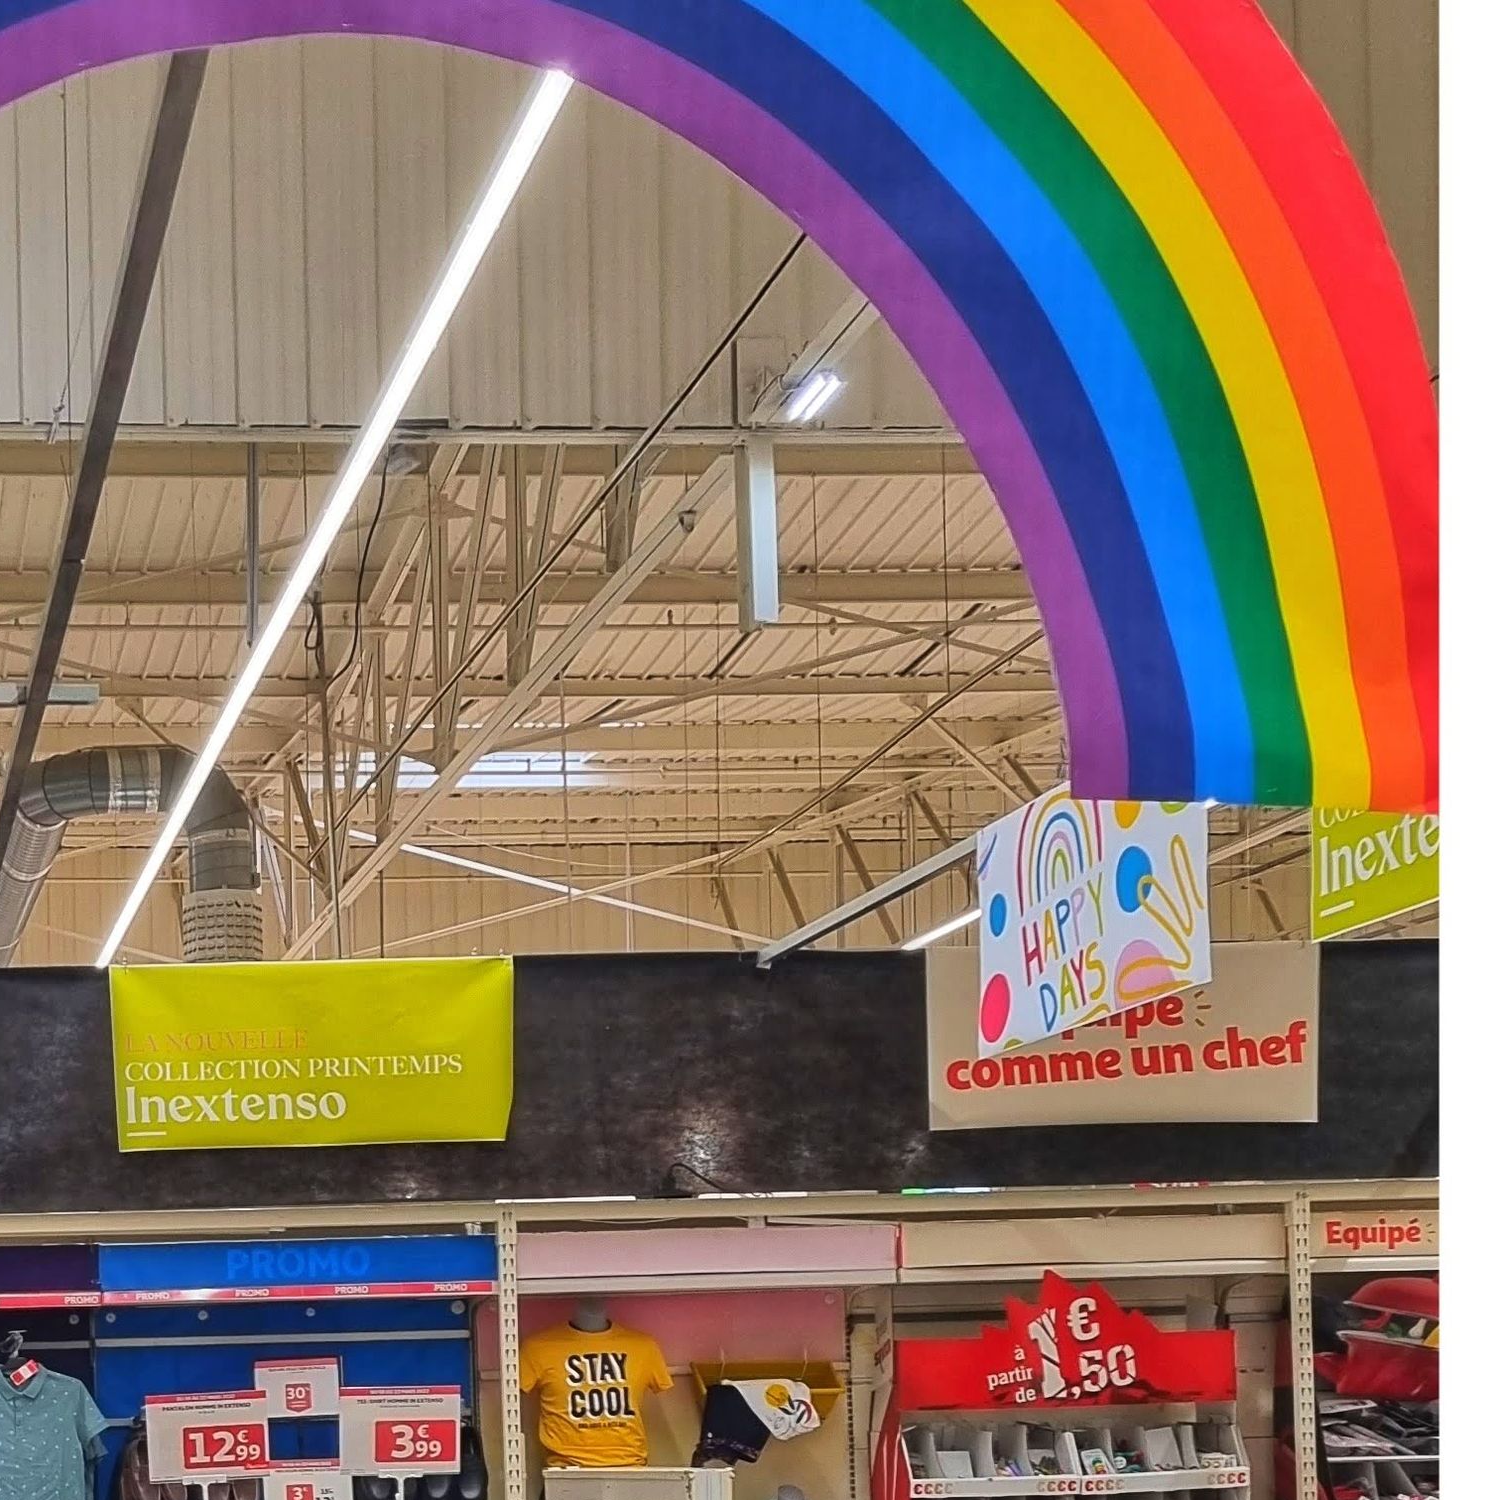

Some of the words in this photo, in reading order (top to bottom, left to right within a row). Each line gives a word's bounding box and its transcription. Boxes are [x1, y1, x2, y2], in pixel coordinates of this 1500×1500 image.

[1022, 873, 1105, 986] HAPPY
[1039, 942, 1108, 1033] DAYS
[125, 1032, 158, 1053] LA
[167, 1030, 308, 1053] NOUVELLE
[946, 1048, 1123, 1091] comme
[1131, 1044, 1194, 1077] un
[1202, 1020, 1307, 1071] chef
[125, 1058, 300, 1082] COLLECTION
[309, 1054, 463, 1079] PRINTEMPS
[125, 1086, 347, 1124] Inextenso
[1326, 1218, 1421, 1250] Equipé
[226, 1247, 372, 1280] PROMO
[64, 1295, 99, 1305] PROMO
[135, 1291, 170, 1300] PROMO
[235, 1288, 270, 1297] PROMO
[334, 1285, 369, 1295] PROMO
[433, 1283, 468, 1292] PROMO
[565, 1352, 627, 1387] STAY
[987, 1366, 1034, 1391] partir
[568, 1386, 636, 1420] COOL
[1015, 1387, 1037, 1404] de
